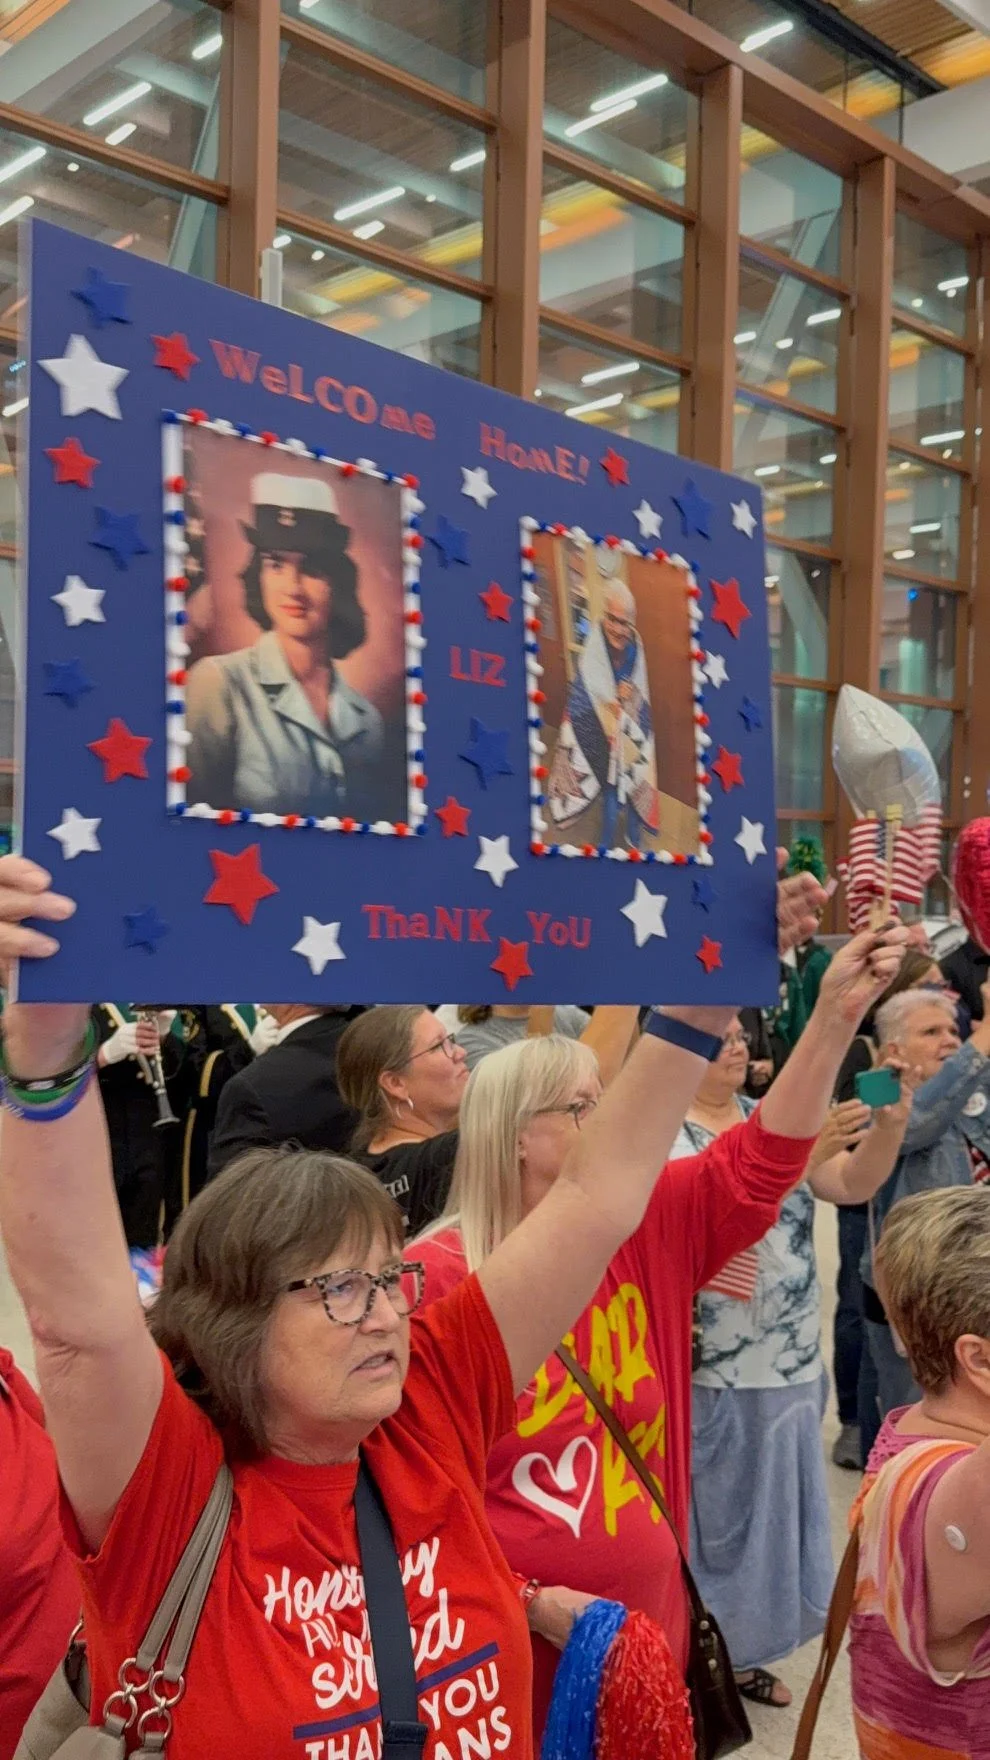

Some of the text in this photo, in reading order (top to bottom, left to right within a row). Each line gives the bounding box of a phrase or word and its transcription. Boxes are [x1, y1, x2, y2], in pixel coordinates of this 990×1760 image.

[450, 646, 506, 686] LIZ
[363, 905, 592, 949] ThaNK YoU
[420, 1662, 499, 1730] YOU
